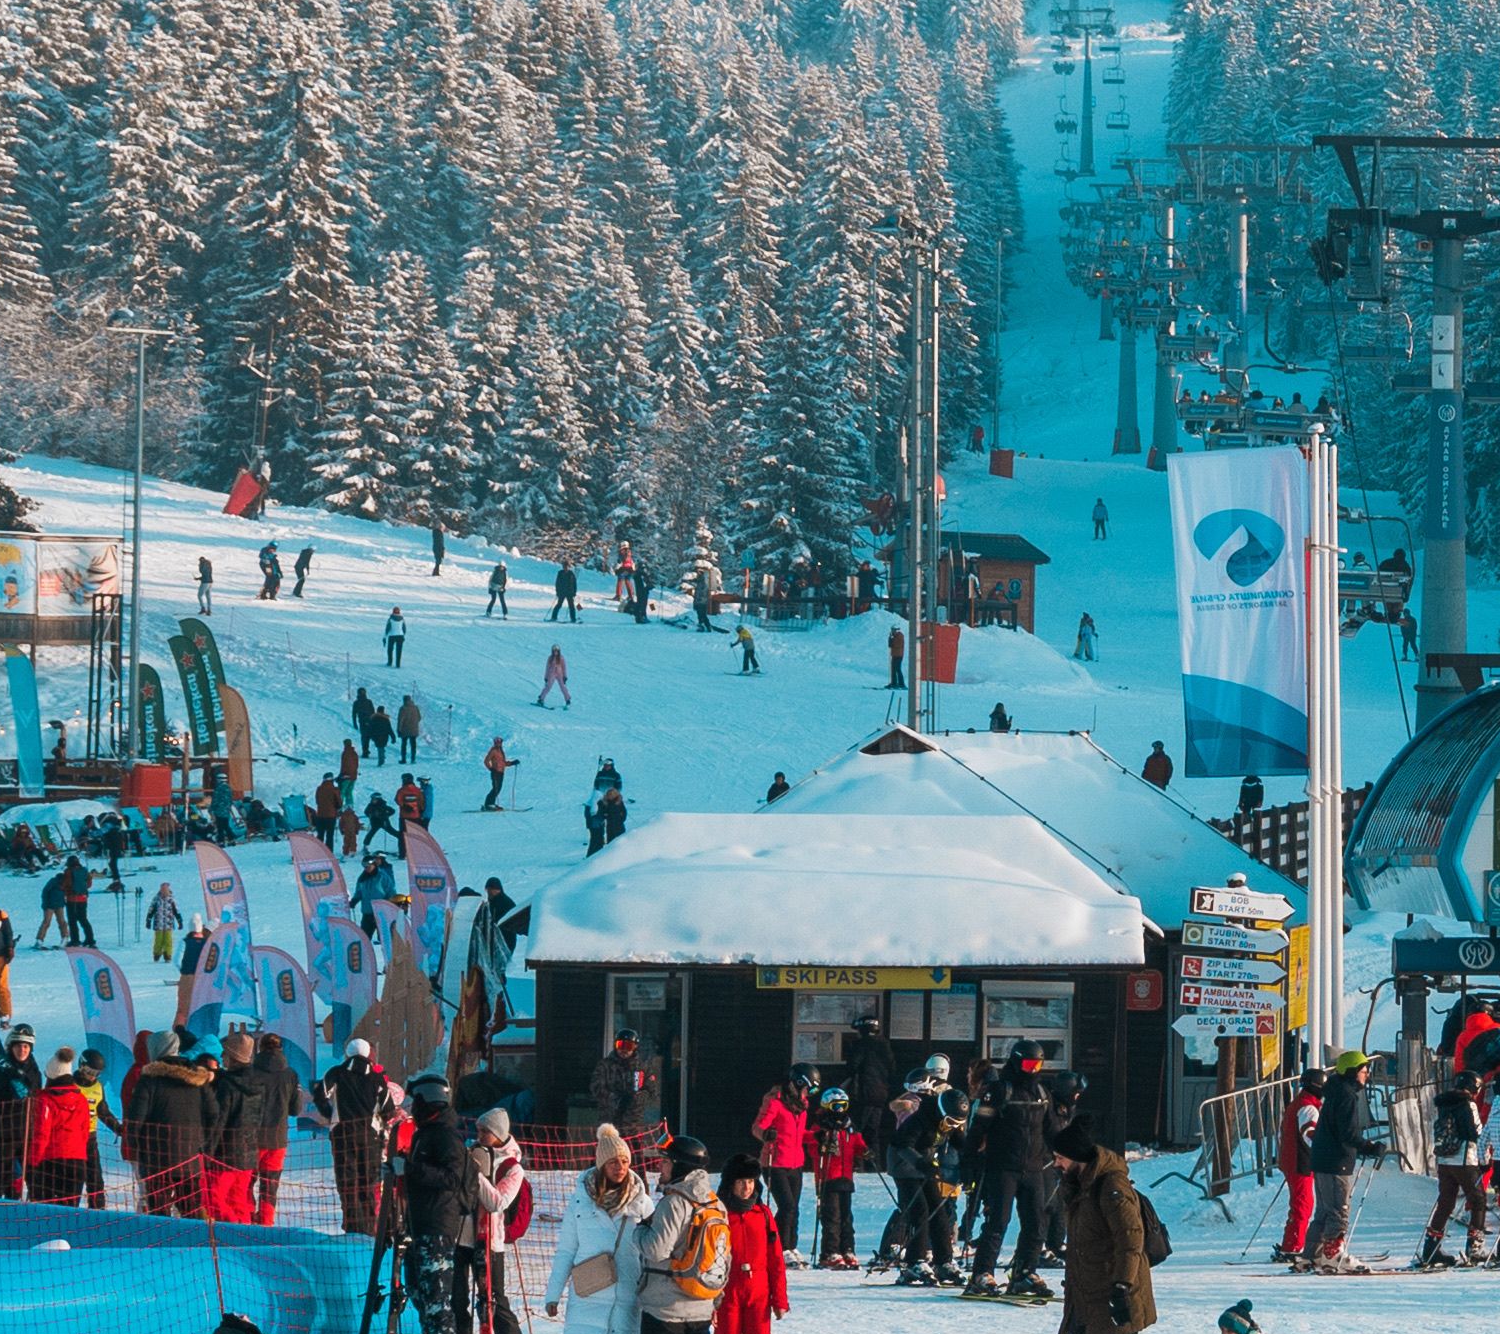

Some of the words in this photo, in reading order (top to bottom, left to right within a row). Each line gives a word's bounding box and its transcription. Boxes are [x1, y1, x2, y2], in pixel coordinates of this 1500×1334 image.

[1230, 896, 1250, 905] BOB
[1217, 904, 1246, 914] START
[1208, 927, 1248, 939] TJUBING
[1207, 937, 1236, 948] START
[1206, 959, 1222, 969] ZIP
[1225, 961, 1244, 970] LINE
[785, 969, 819, 985] SKI
[825, 969, 878, 985] PASS
[1205, 968, 1235, 978] START
[1203, 987, 1255, 1000] AMBULANTA
[1203, 997, 1237, 1008] TRAUMA
[1239, 1000, 1273, 1011] CENTAR
[1227, 1017, 1254, 1026] GRAD
[1236, 1026, 1254, 1034] 40m
